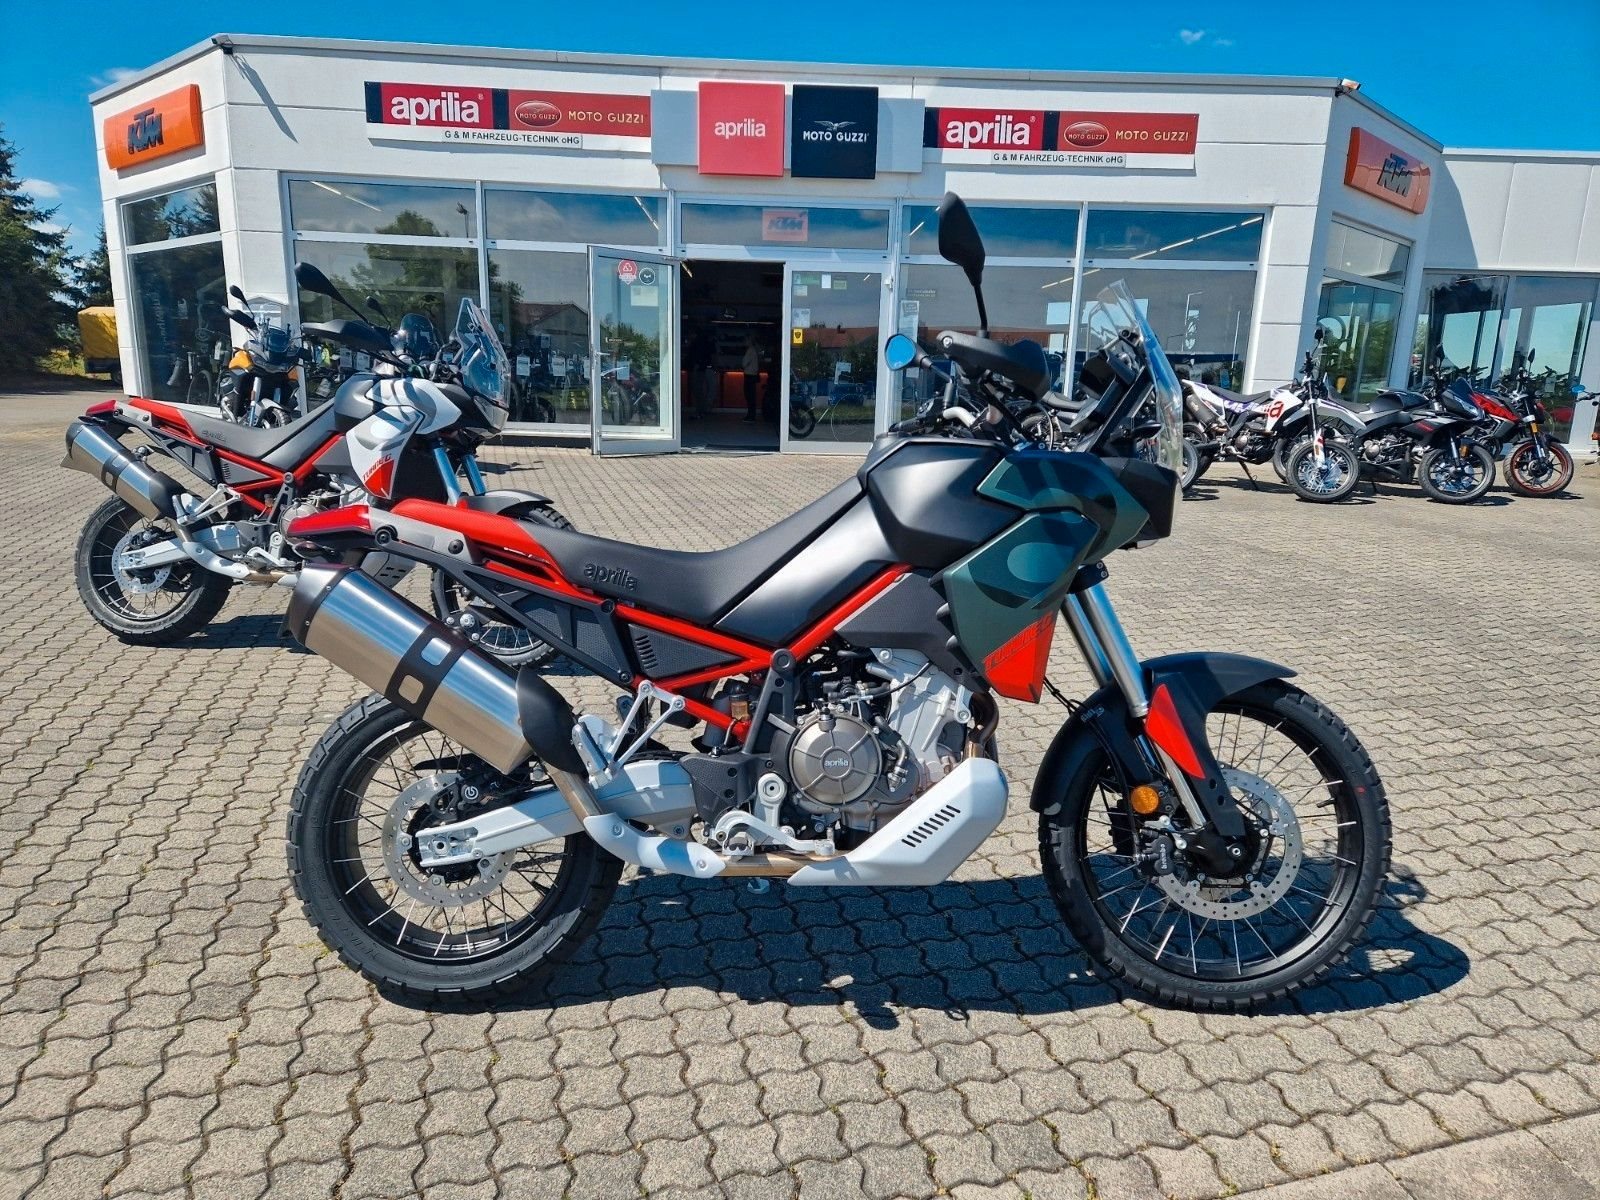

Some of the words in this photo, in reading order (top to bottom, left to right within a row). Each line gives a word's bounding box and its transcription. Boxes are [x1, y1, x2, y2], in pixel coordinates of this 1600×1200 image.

[390, 91, 480, 125] aprilia
[519, 112, 538, 120] MOTO
[538, 113, 559, 121] GUZZI
[568, 110, 603, 122] MOTO
[607, 112, 644, 124] GUZZI
[127, 107, 164, 155] KTM
[714, 118, 766, 139] aprilia
[945, 115, 1030, 149] aprilia
[444, 130, 452, 139] G
[452, 131, 460, 140] &
[462, 131, 470, 140] M
[471, 132, 560, 144] FAHRZEUG-TECHNIK
[802, 130, 832, 142] MOTO
[835, 131, 867, 143] GUZZI
[1086, 133, 1105, 141] GUZZI
[1115, 130, 1148, 141] MOTO
[1153, 131, 1189, 142] GUZZI
[993, 153, 1001, 161] G
[1001, 153, 1008, 162] &
[1009, 154, 1018, 162] M
[1019, 154, 1104, 164] FAHRZEUG-TECHNIK
[583, 562, 639, 591] aprilia
